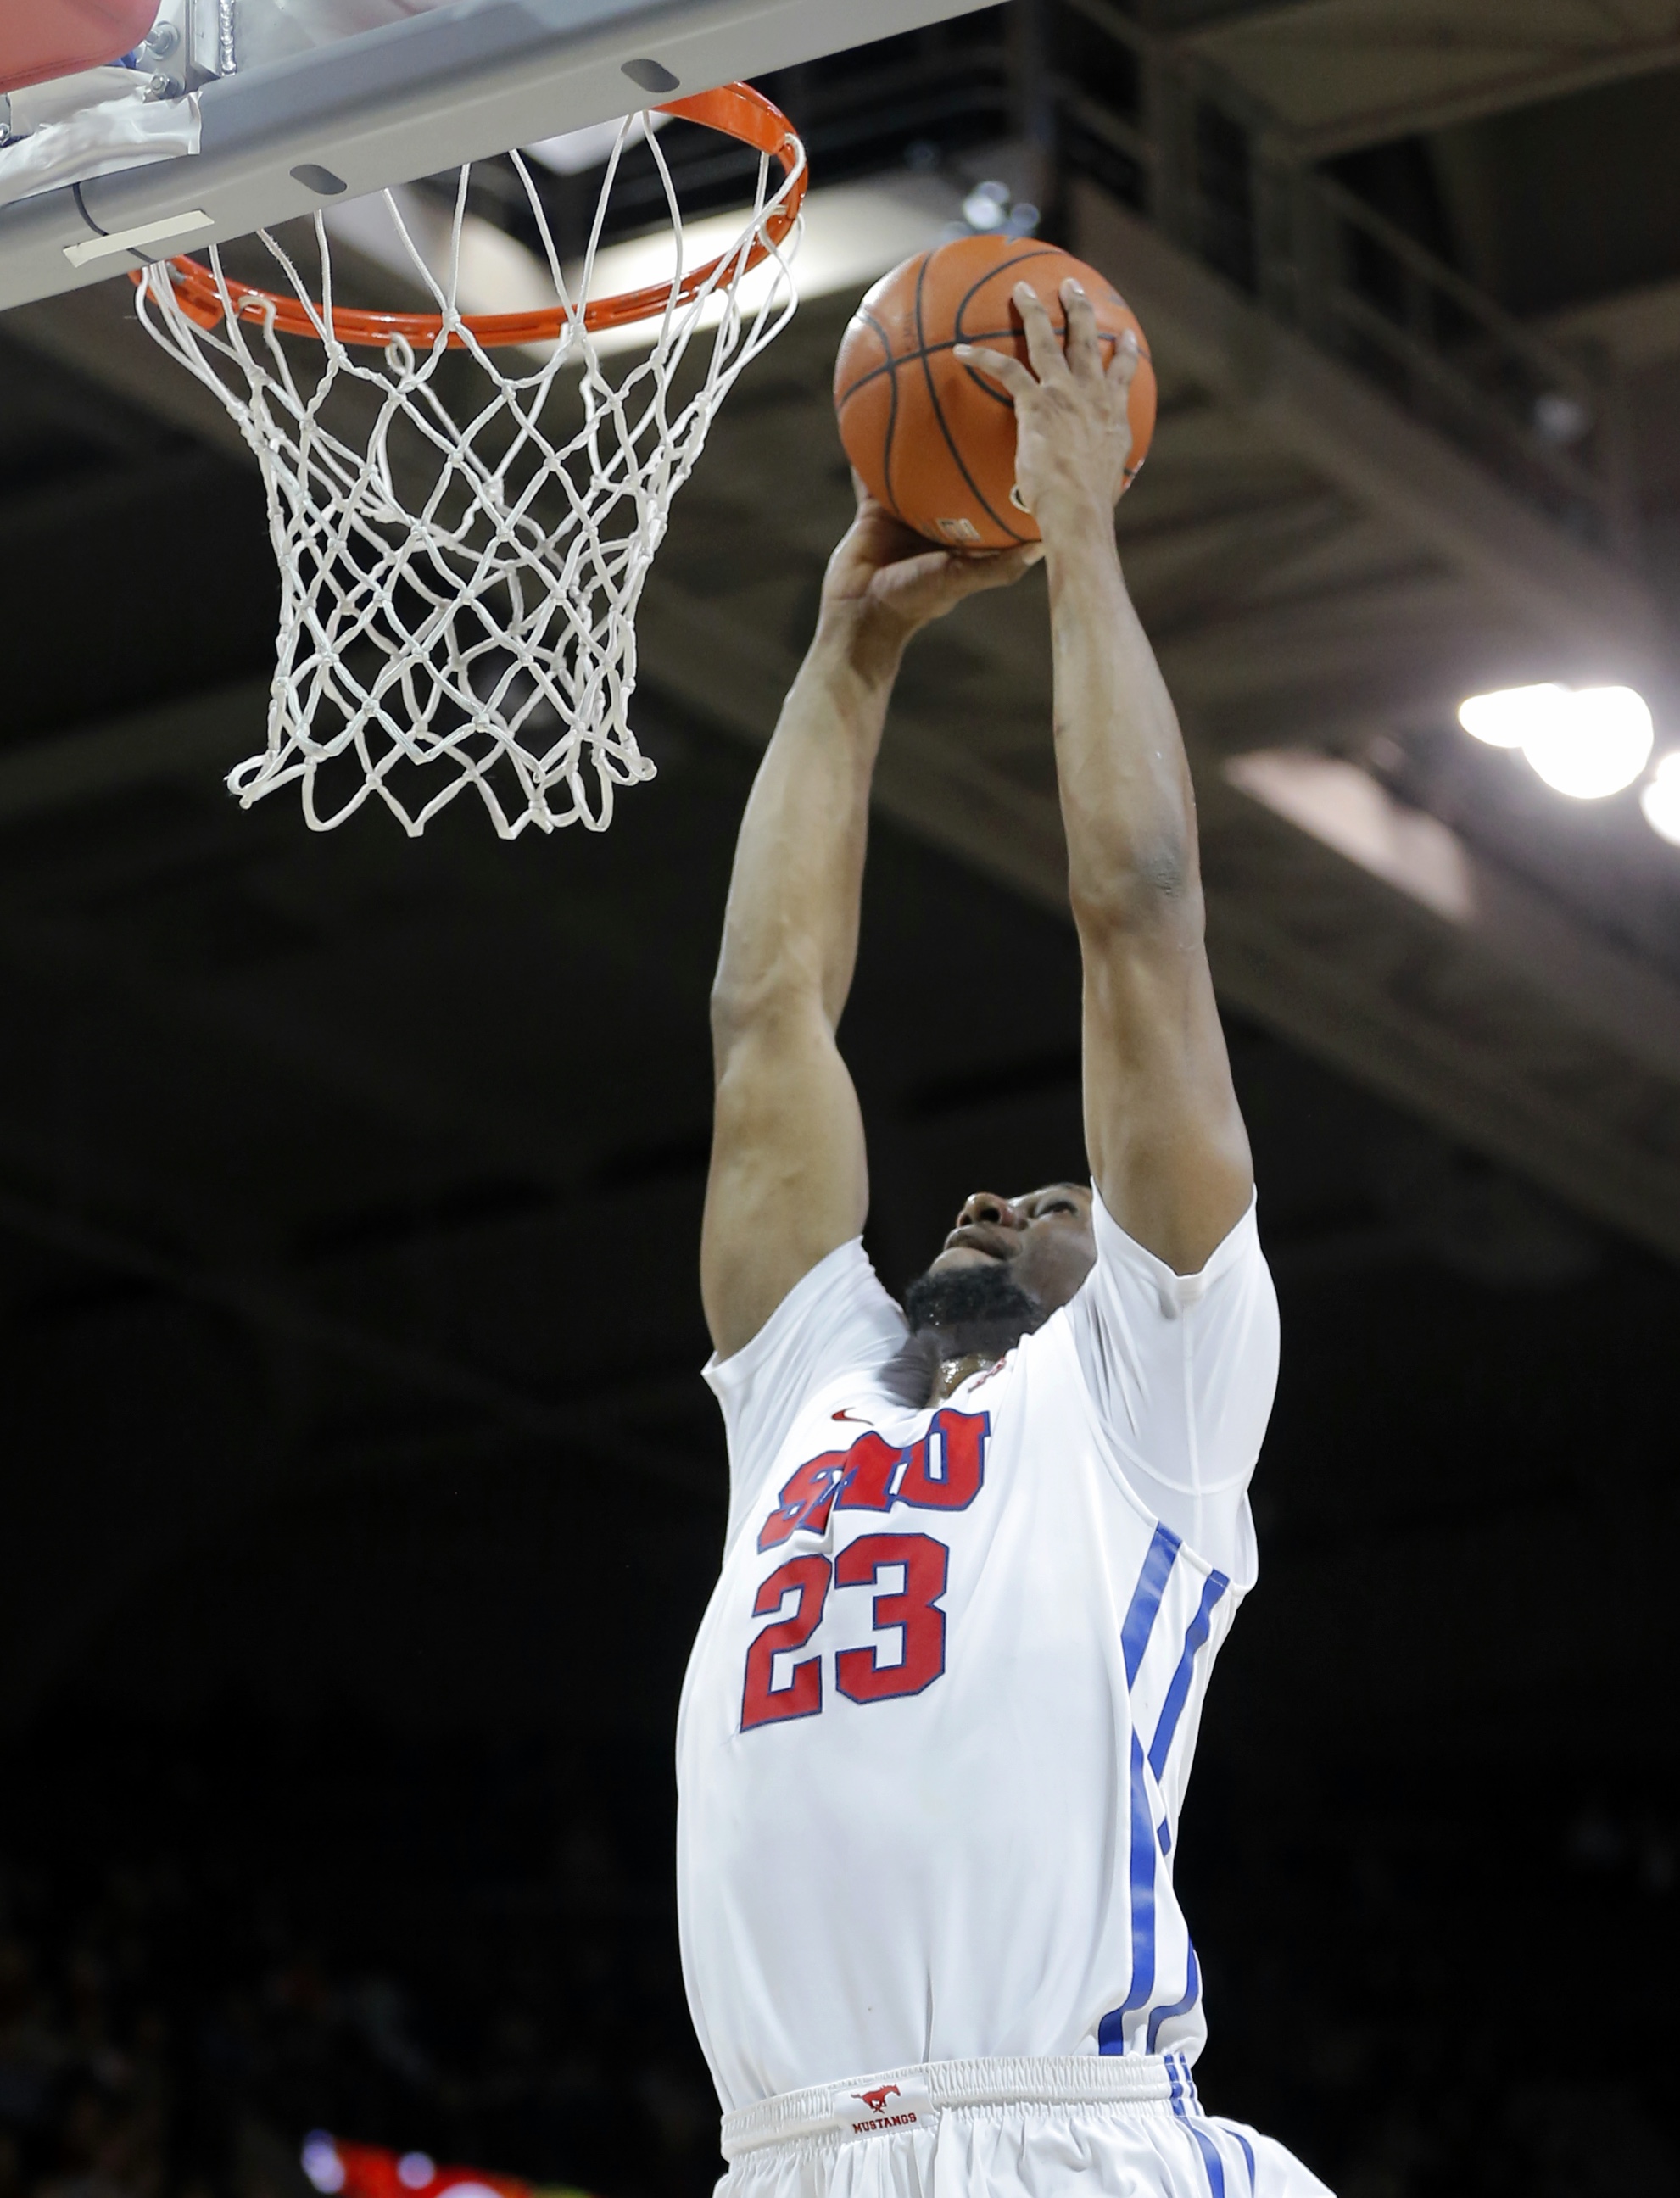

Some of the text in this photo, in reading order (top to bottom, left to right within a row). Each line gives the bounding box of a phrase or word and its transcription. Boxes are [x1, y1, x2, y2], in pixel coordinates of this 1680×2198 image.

[757, 1408, 991, 1555] SMU
[740, 1532, 950, 1734] 23
[851, 2112, 917, 2134] MUSTANGS
